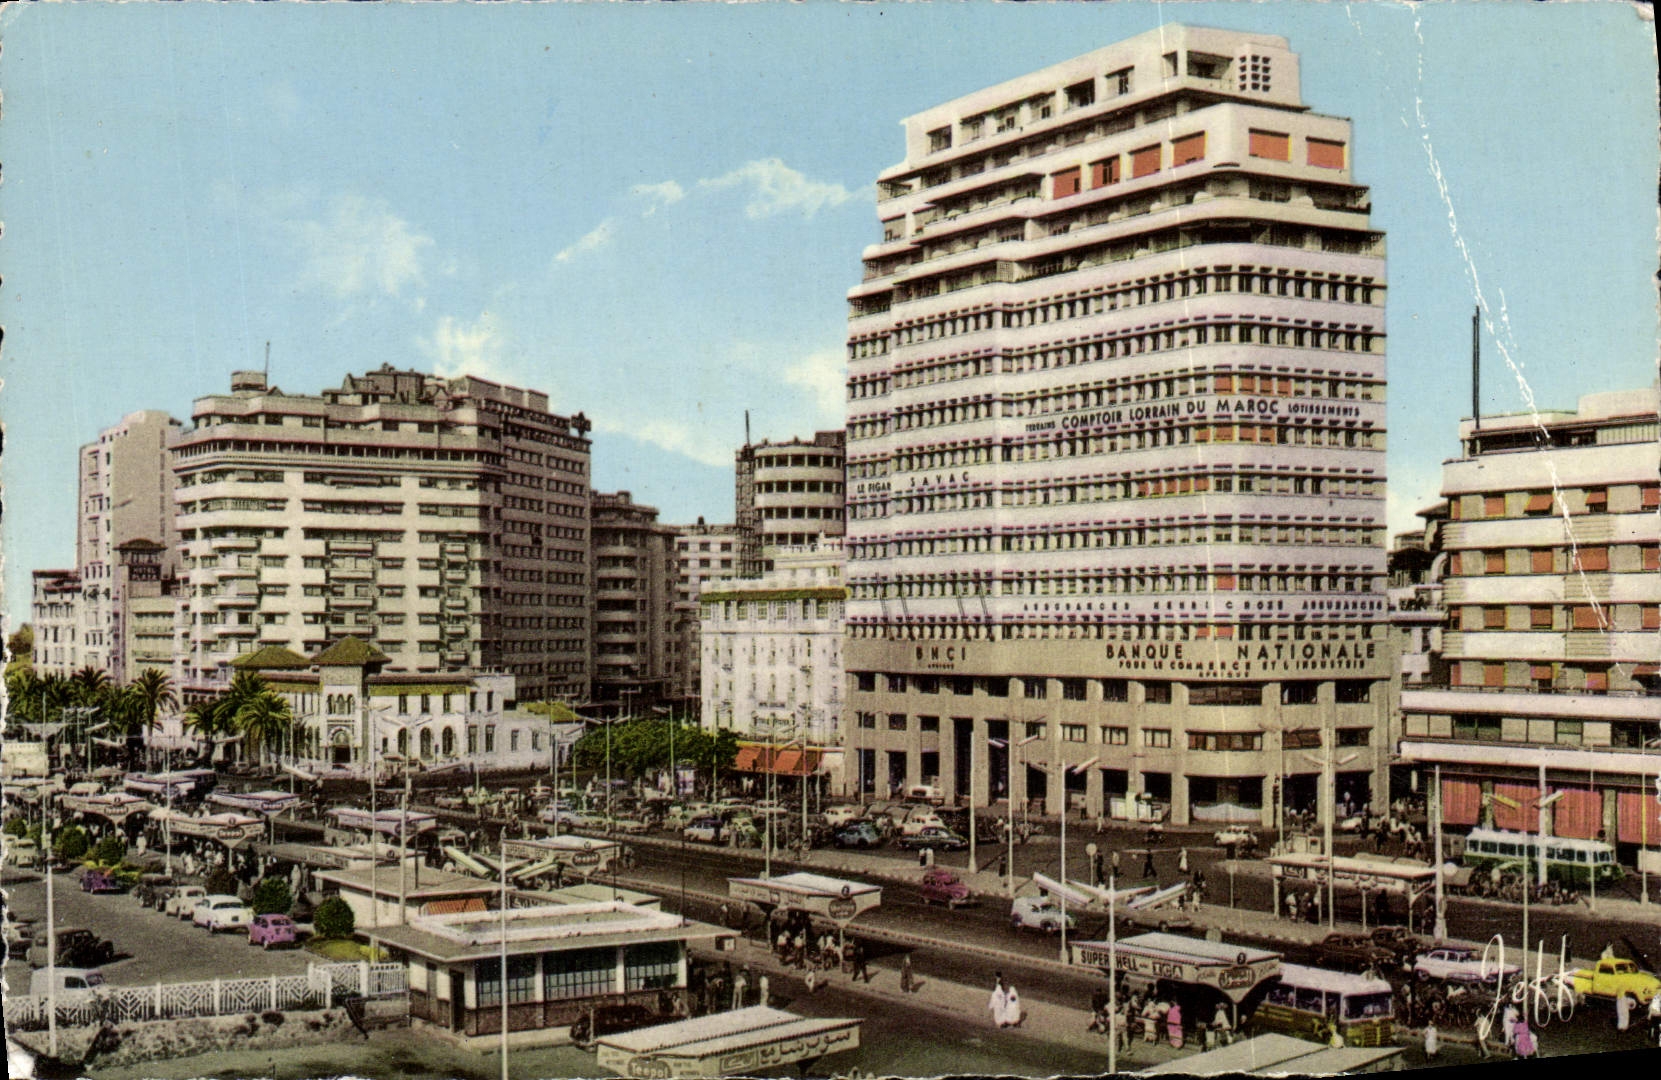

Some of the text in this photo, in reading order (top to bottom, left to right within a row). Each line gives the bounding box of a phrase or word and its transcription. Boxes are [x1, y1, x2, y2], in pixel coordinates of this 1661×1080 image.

[1062, 410, 1123, 429] COMPTOIR
[1129, 402, 1180, 421] LORRAIN
[1186, 399, 1206, 414] DU
[1216, 399, 1279, 414] MAROC
[1288, 403, 1360, 417] LOTISSEMENTS
[910, 471, 969, 487] SAVAC
[915, 645, 966, 660] BNCI
[1106, 642, 1376, 660] BANQUE NATIONALE
[1119, 660, 1146, 670] POUR
[1153, 660, 1163, 670] LE
[1170, 660, 1251, 671] COMMERCE
[1081, 949, 1110, 966] SUPER
[1111, 953, 1139, 971] HELL
